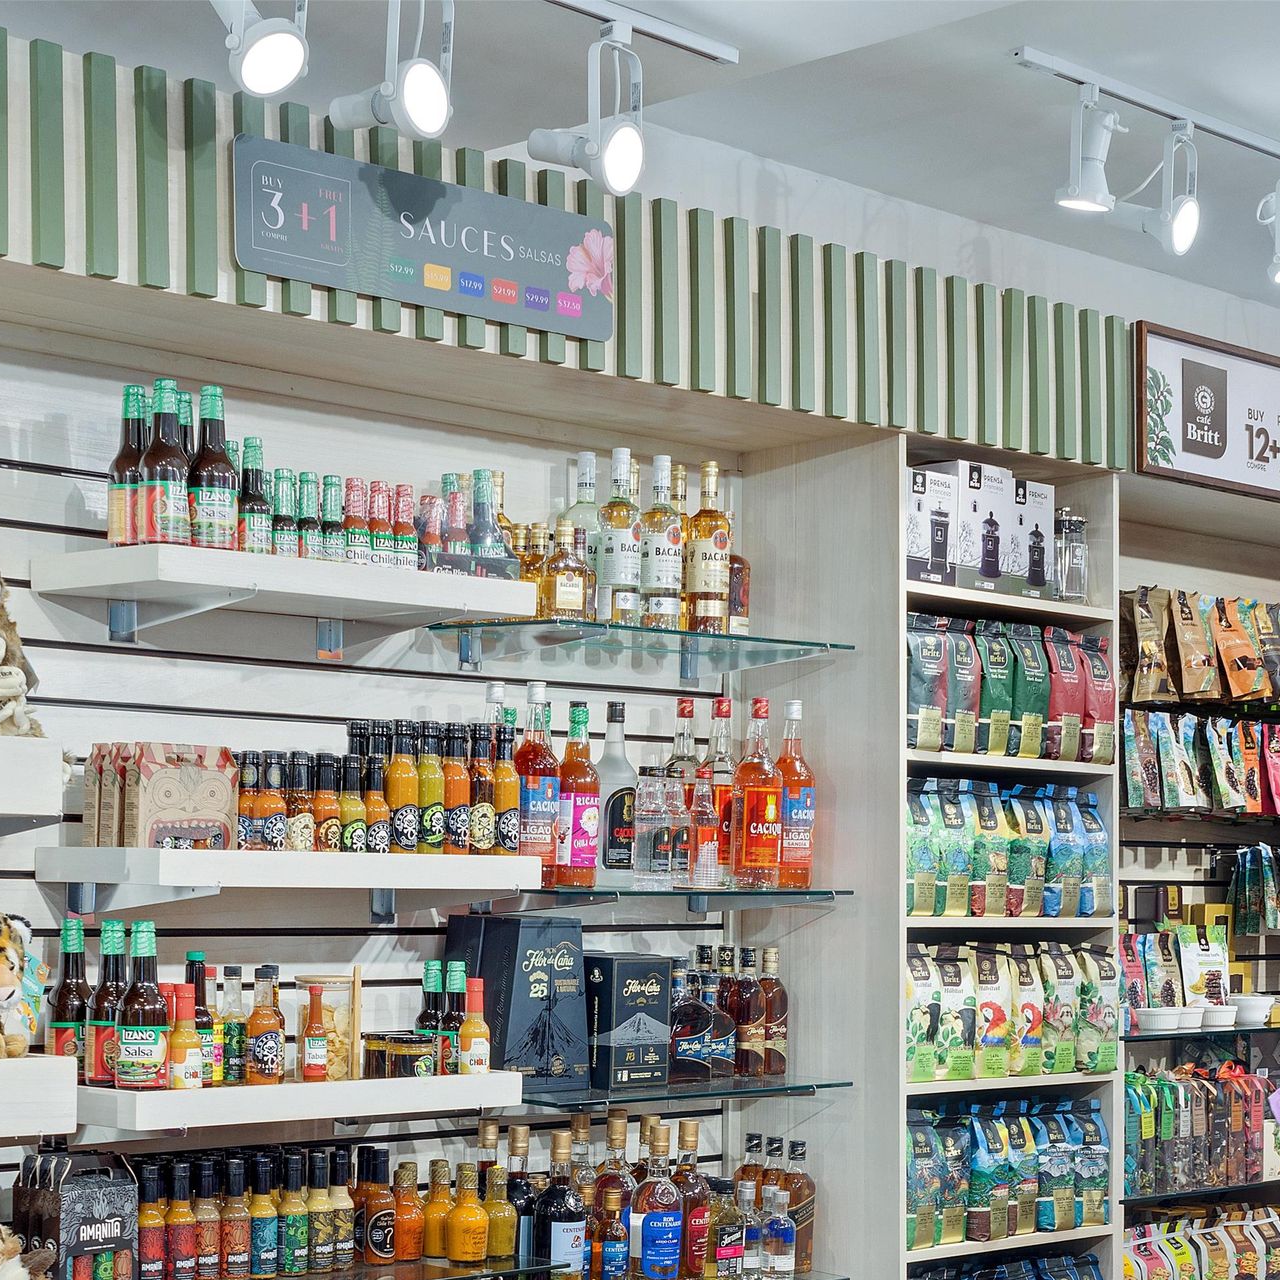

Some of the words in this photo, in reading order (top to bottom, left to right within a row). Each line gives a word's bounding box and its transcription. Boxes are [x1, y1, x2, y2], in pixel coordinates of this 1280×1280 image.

[261, 174, 284, 189] BUY
[399, 210, 515, 262] SAUCES
[518, 246, 561, 266] SALSAS
[390, 263, 415, 277] $12.99
[460, 278, 483, 291] $17.99
[493, 284, 516, 297] $21.99
[525, 292, 549, 305] $29.99
[1247, 408, 1265, 422] BUY
[930, 478, 951, 490] PRENSA
[984, 474, 1003, 486] PRENSA
[199, 489, 231, 504] LIZANO
[1028, 490, 1048, 500] FRENCH
[201, 506, 231, 520] Salsa
[324, 548, 345, 558] Salsa
[922, 649, 939, 658] Britt
[990, 655, 1005, 664] Britt
[522, 949, 547, 972] Flor
[554, 948, 575, 970] Caña
[980, 973, 997, 982] Britt
[528, 982, 548, 998] 25
[623, 978, 644, 996] Flor
[645, 979, 661, 995] Caña
[123, 1028, 155, 1042] LIZANO
[124, 1046, 153, 1057] Salsa
[79, 1218, 122, 1242] AMANITA
[176, 1258, 196, 1269] AMANITA
[228, 1254, 248, 1266] AMANITA
[141, 1262, 163, 1273] AMANITA
